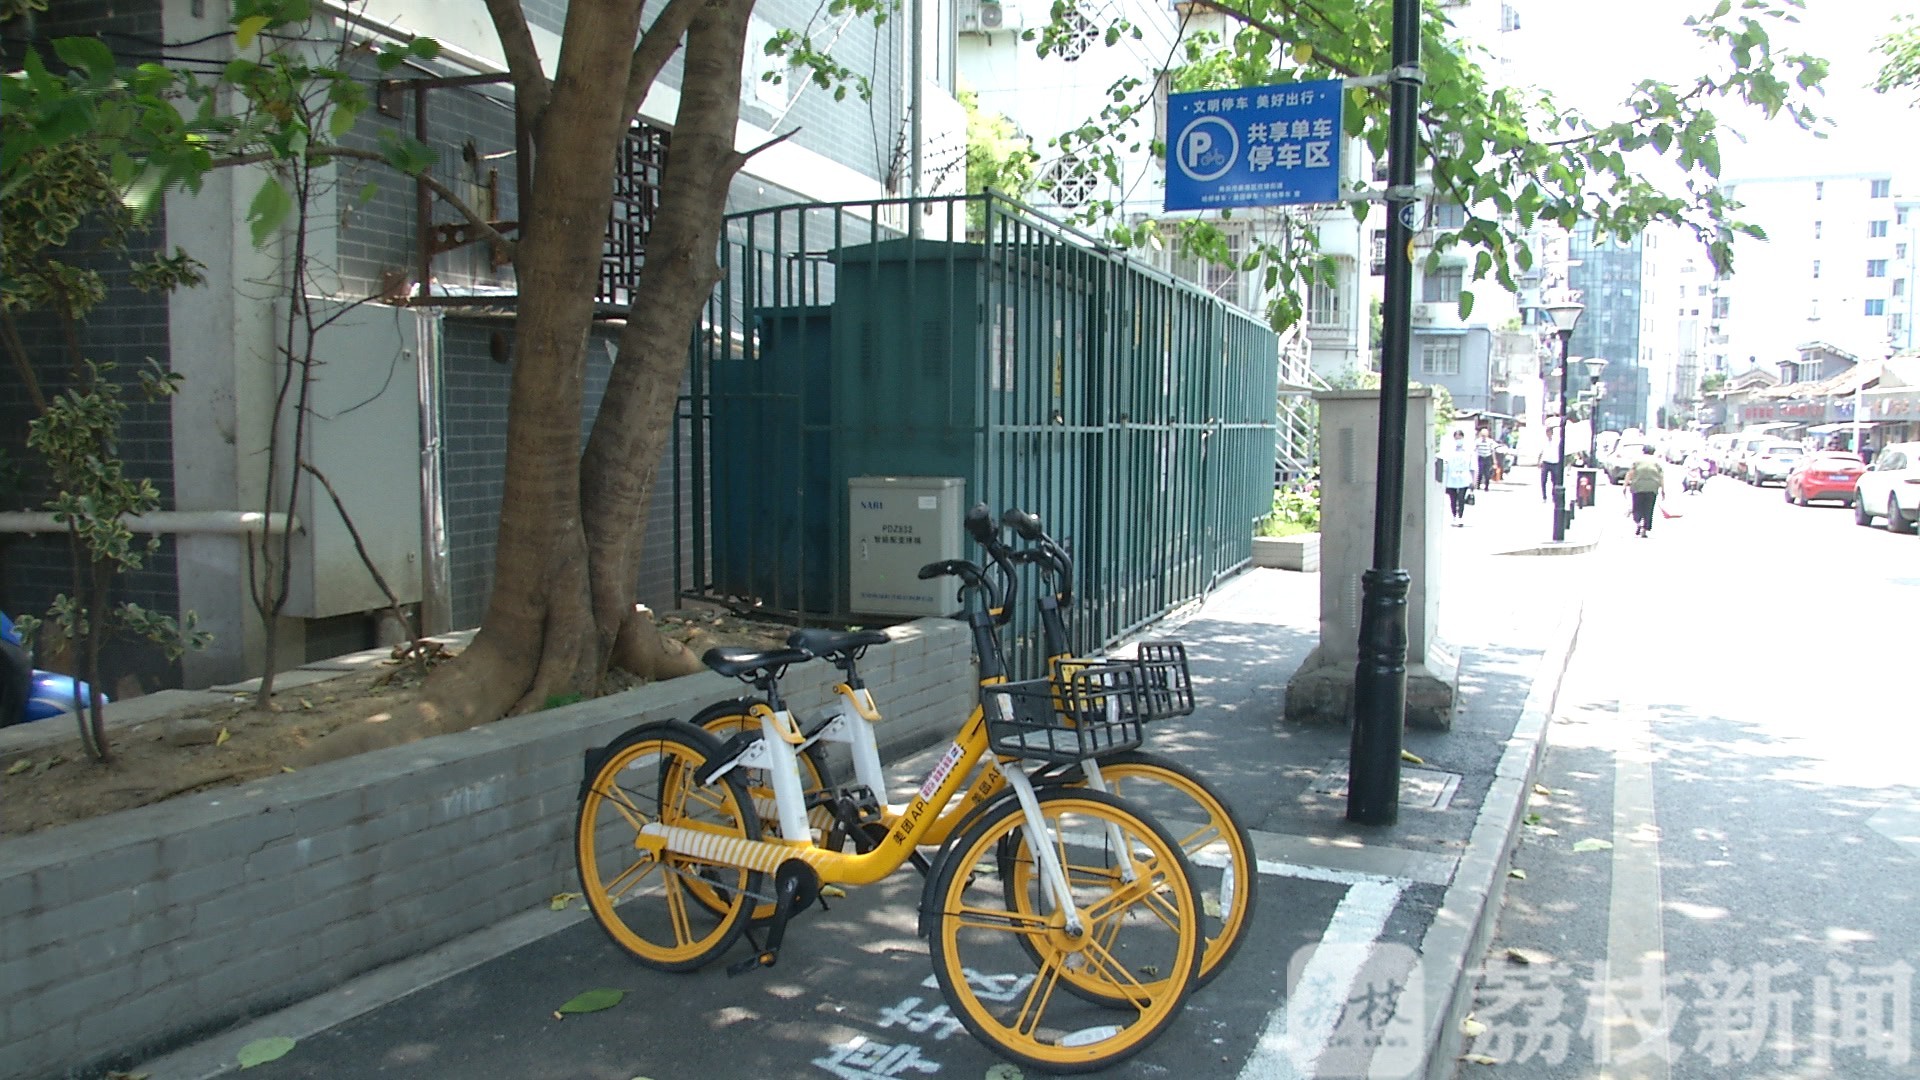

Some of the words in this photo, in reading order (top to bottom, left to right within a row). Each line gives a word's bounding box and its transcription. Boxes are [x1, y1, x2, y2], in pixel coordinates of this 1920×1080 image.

[1194, 97, 1248, 113] 文明停车
[1257, 91, 1314, 109] 美好出行
[1248, 118, 1332, 144] 共享单车
[1189, 131, 1212, 168] P
[1247, 141, 1330, 172] 停车区
